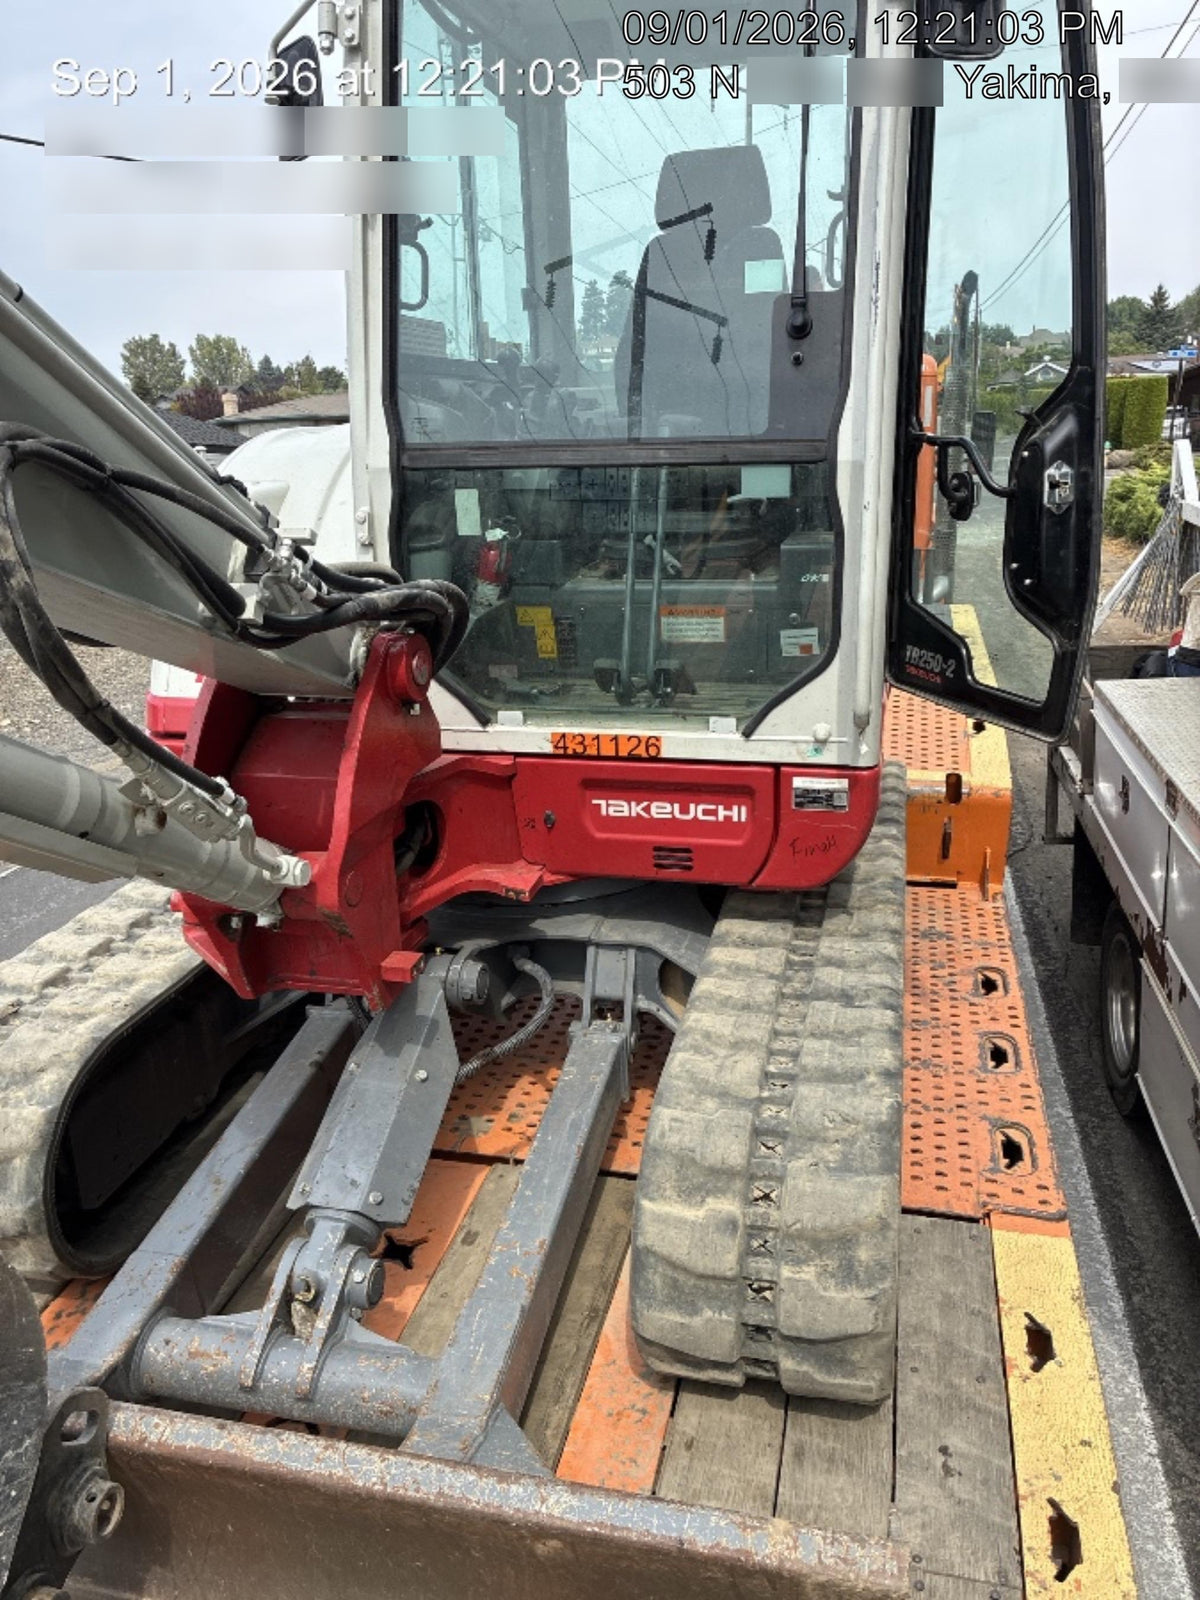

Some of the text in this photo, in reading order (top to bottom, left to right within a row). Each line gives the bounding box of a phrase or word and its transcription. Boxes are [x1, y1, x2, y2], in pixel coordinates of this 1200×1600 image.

[905, 644, 956, 678] TB250-2
[553, 732, 661, 758] 431126
[591, 799, 748, 822] TAKEUCHI
